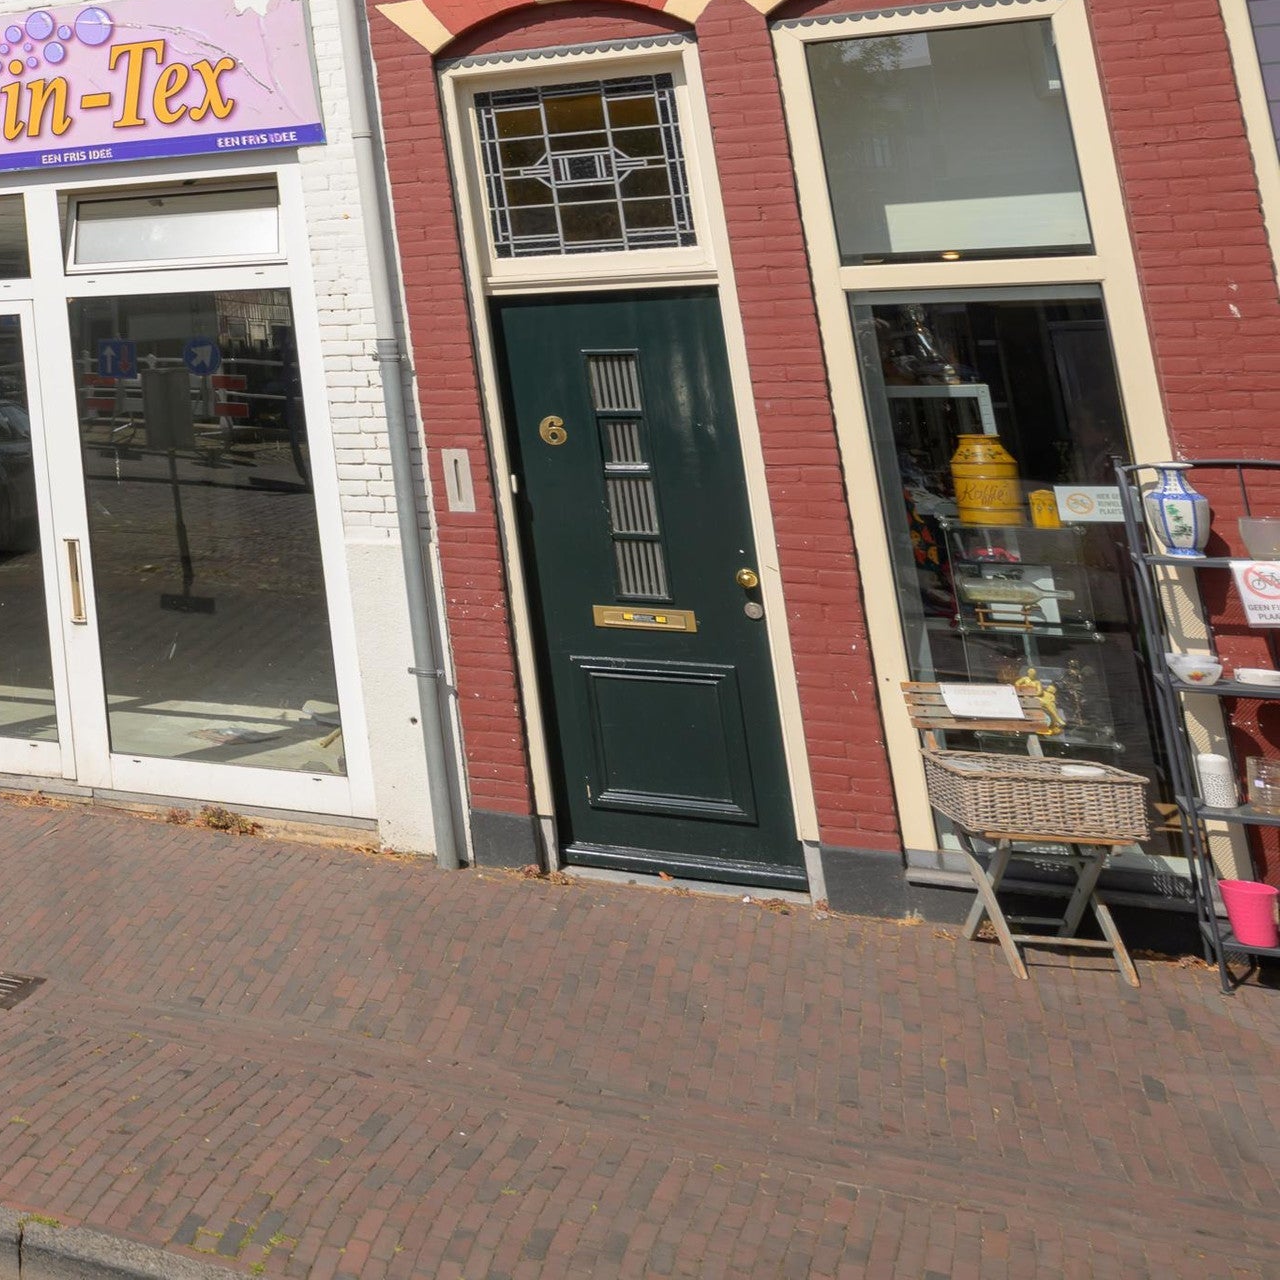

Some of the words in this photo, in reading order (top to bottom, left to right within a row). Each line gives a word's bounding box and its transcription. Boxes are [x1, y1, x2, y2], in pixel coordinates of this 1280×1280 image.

[216, 136, 240, 148] EEN
[241, 134, 268, 146] FRIS
[268, 131, 298, 144] IDEE
[41, 153, 63, 165] EEN
[63, 151, 88, 163] FRIS
[88, 148, 114, 160] IDEE
[539, 414, 569, 446] 6
